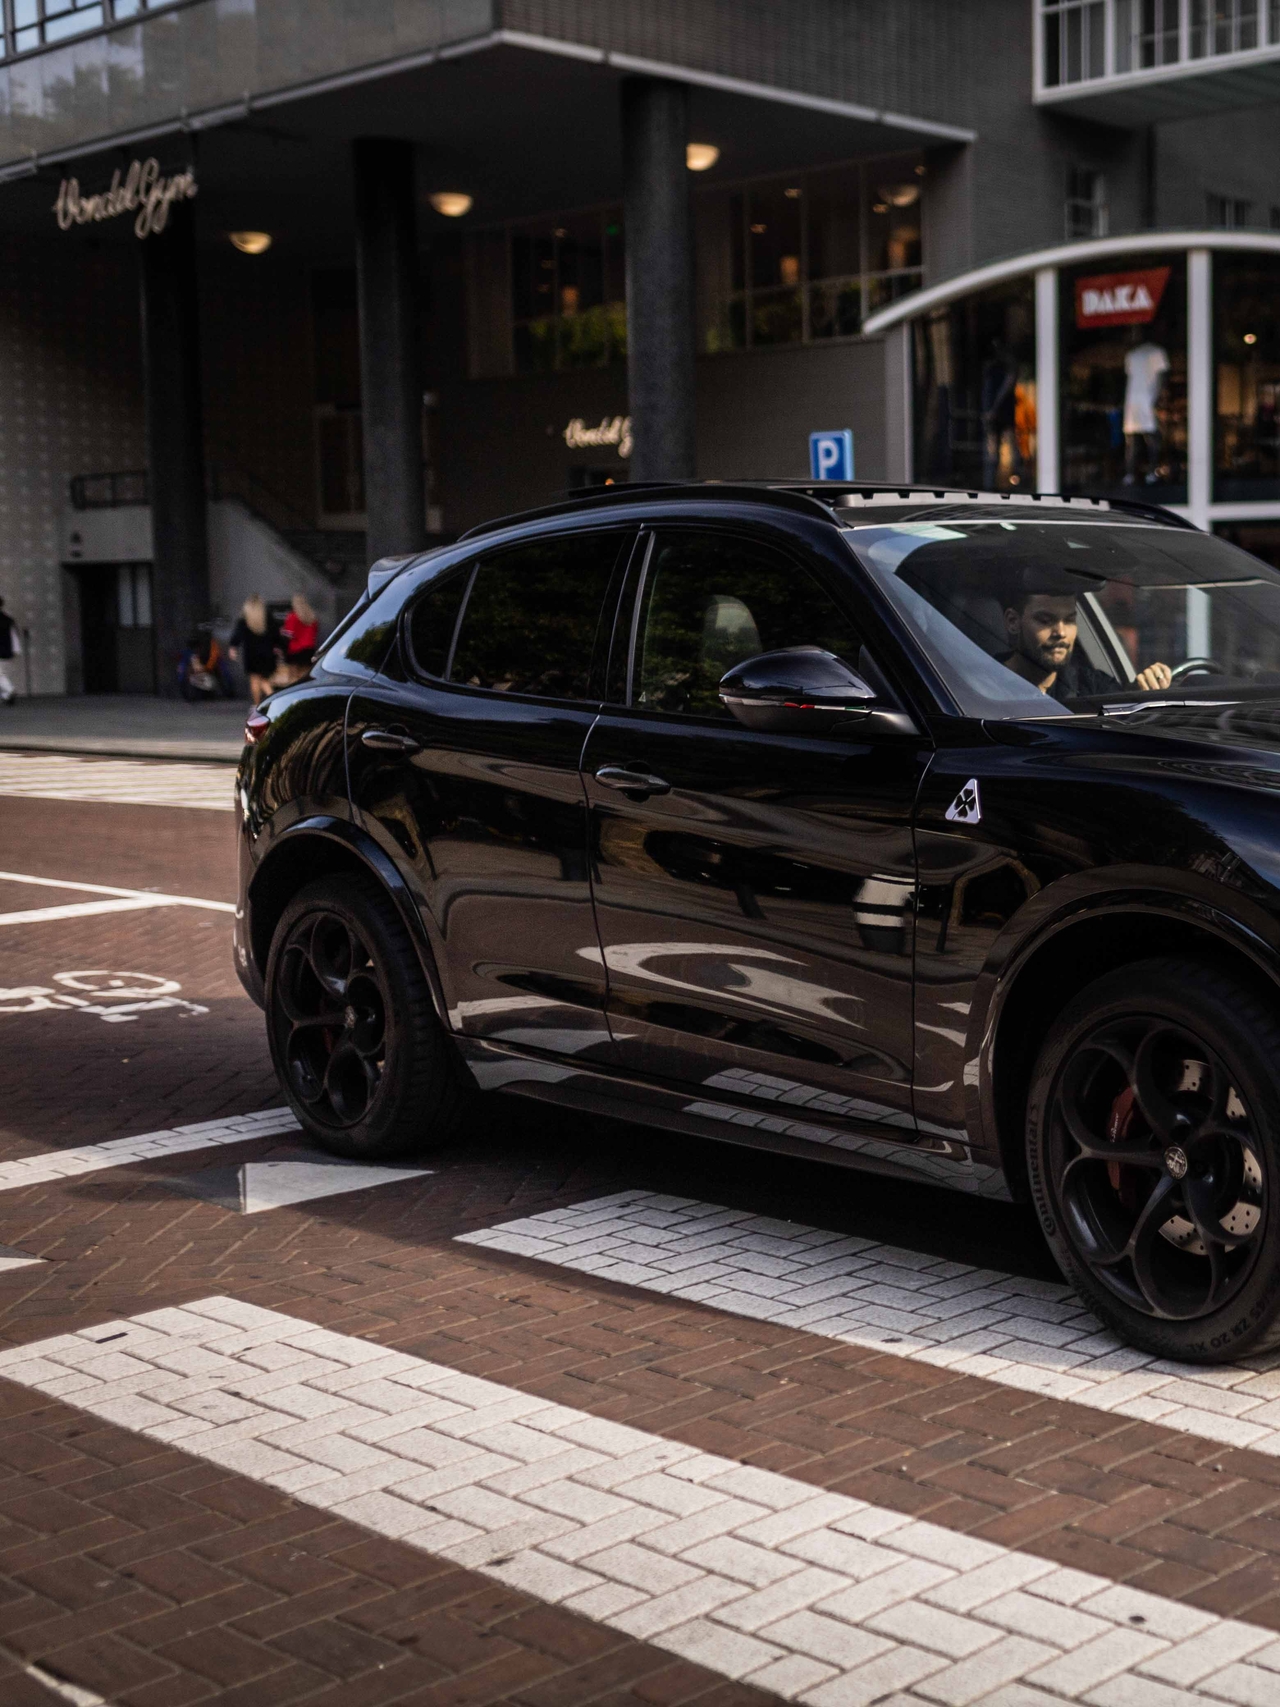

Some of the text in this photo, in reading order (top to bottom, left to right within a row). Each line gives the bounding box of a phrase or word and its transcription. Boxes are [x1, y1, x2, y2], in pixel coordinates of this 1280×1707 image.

[1081, 284, 1154, 317] DAKA
[818, 440, 839, 480] P
[1027, 1119, 1056, 1237] Continental
[1210, 1332, 1230, 1350] 20
